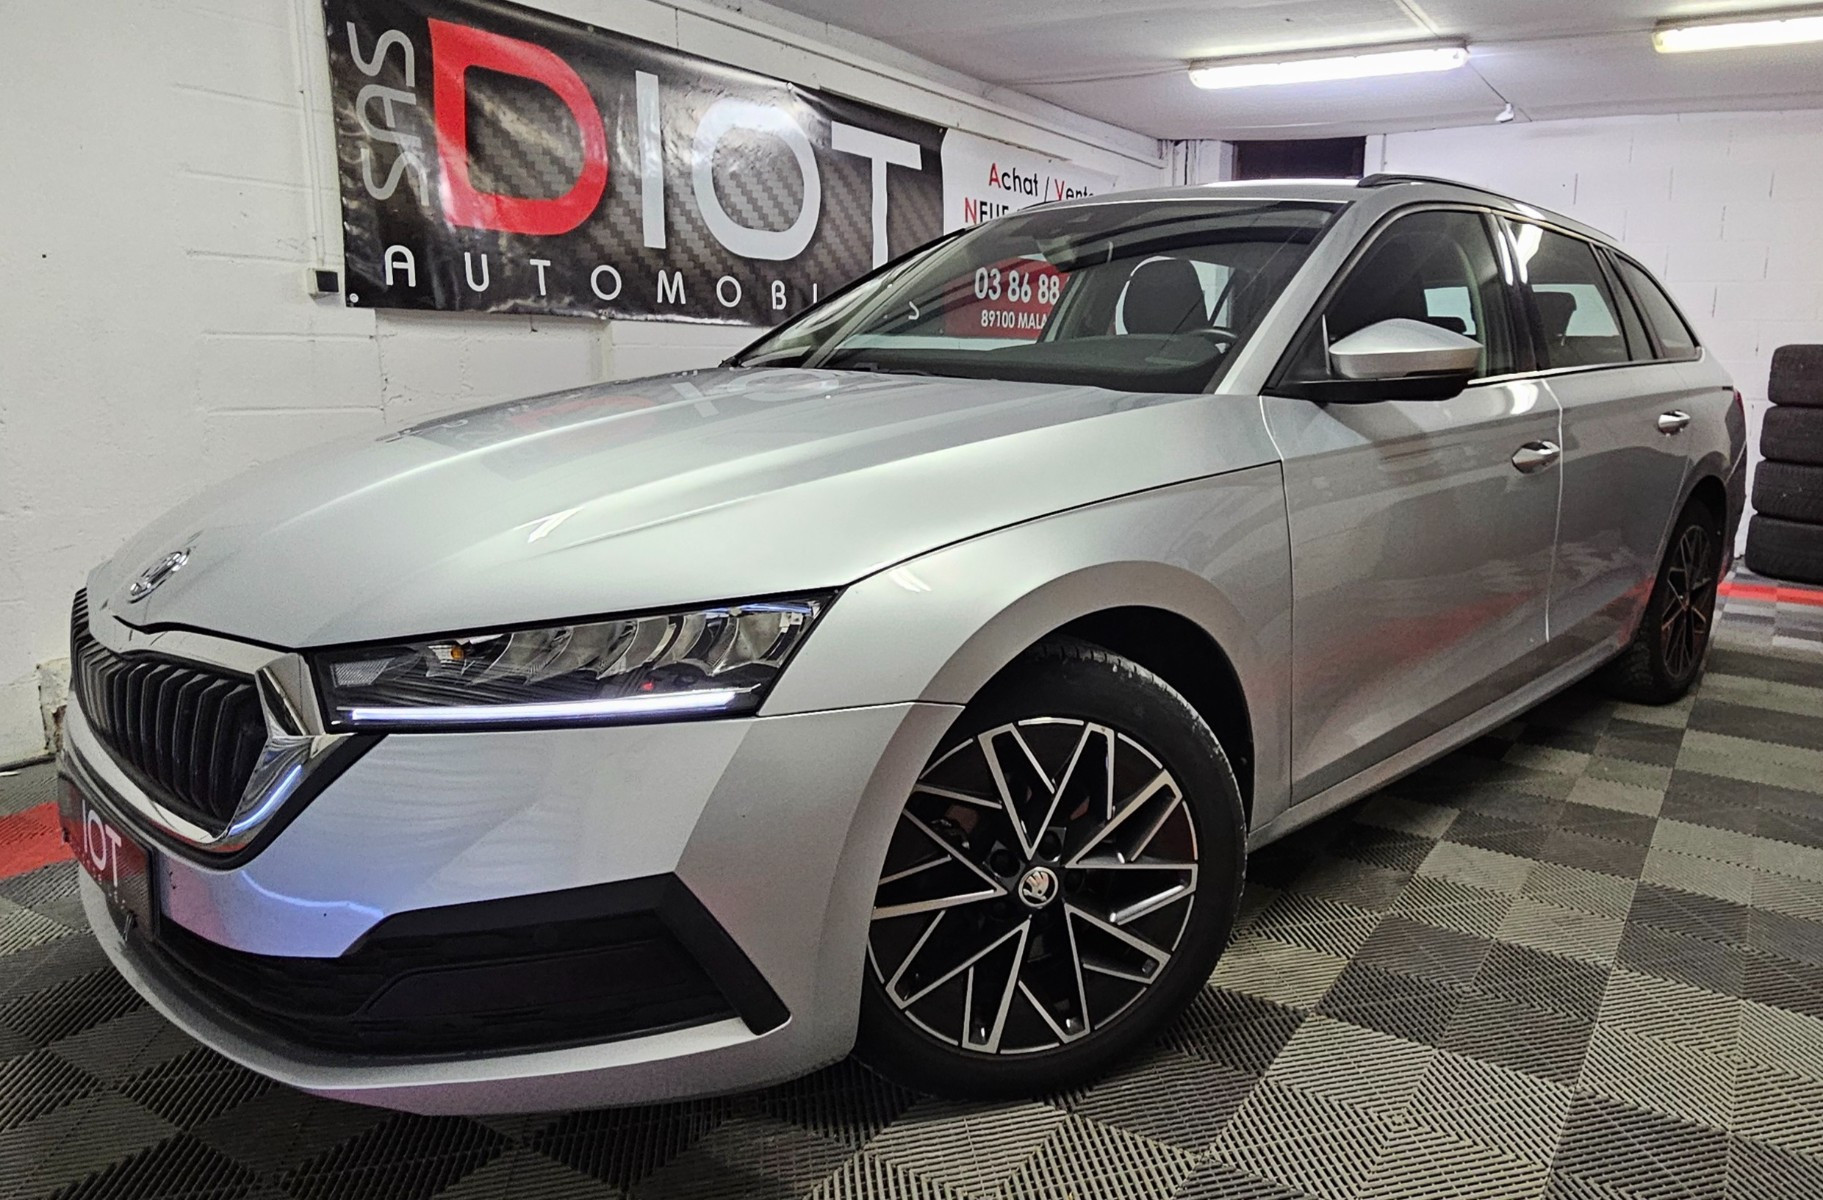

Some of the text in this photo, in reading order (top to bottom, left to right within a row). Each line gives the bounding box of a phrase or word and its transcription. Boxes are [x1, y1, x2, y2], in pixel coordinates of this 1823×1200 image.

[346, 21, 430, 207] SAS
[428, 17, 922, 270] DIOT
[988, 163, 1039, 197] Achat
[974, 267, 1060, 305] 03 86 88
[981, 309, 1049, 330] 89100 MALA
[81, 799, 122, 888] IOT
